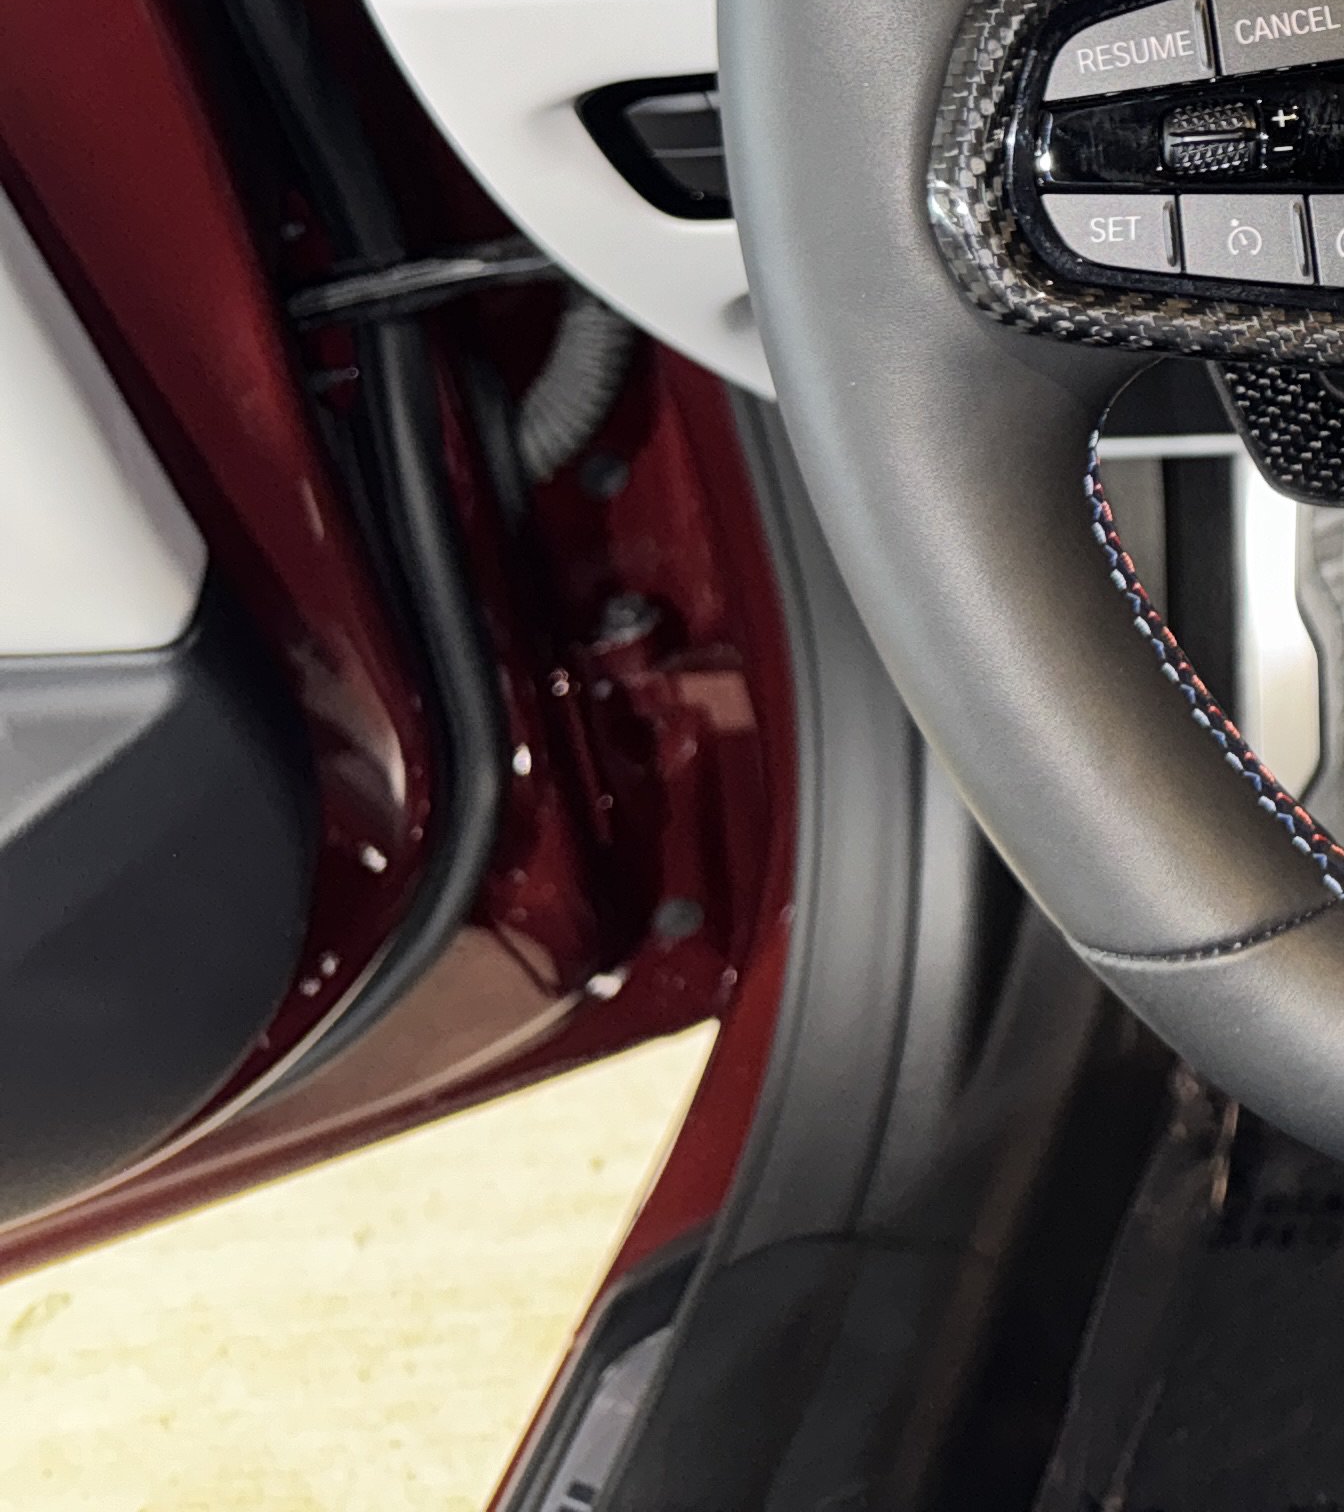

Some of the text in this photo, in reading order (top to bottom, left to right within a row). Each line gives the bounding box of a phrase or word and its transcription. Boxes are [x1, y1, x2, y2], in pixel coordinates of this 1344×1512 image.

[1235, 5, 1341, 45] CANCEL
[1078, 30, 1194, 75] RESUME
[1090, 216, 1141, 243] SET
